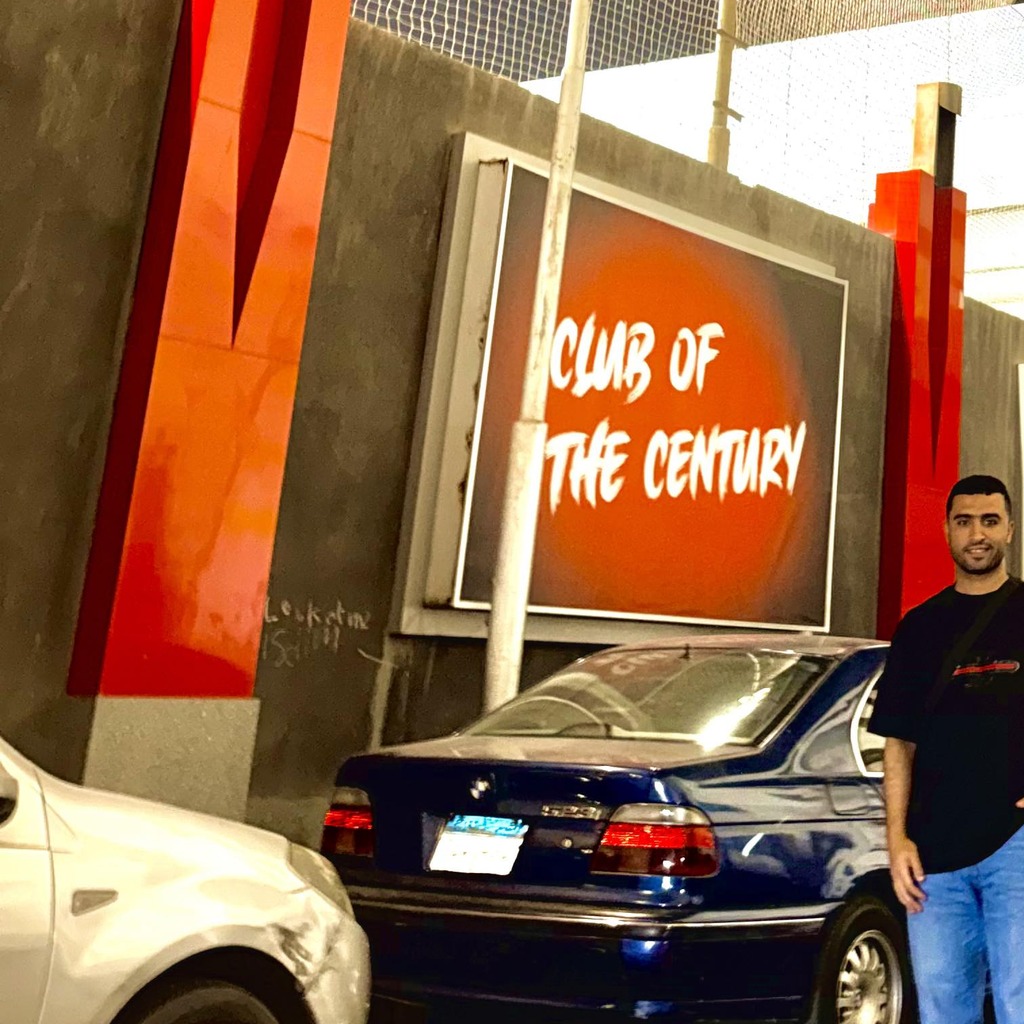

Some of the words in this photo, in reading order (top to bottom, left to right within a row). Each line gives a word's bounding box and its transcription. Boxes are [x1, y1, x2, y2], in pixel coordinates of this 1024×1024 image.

[550, 312, 655, 404] CLUB
[669, 323, 725, 395] OF
[545, 417, 631, 515] THE
[644, 421, 806, 504] CENTURY
